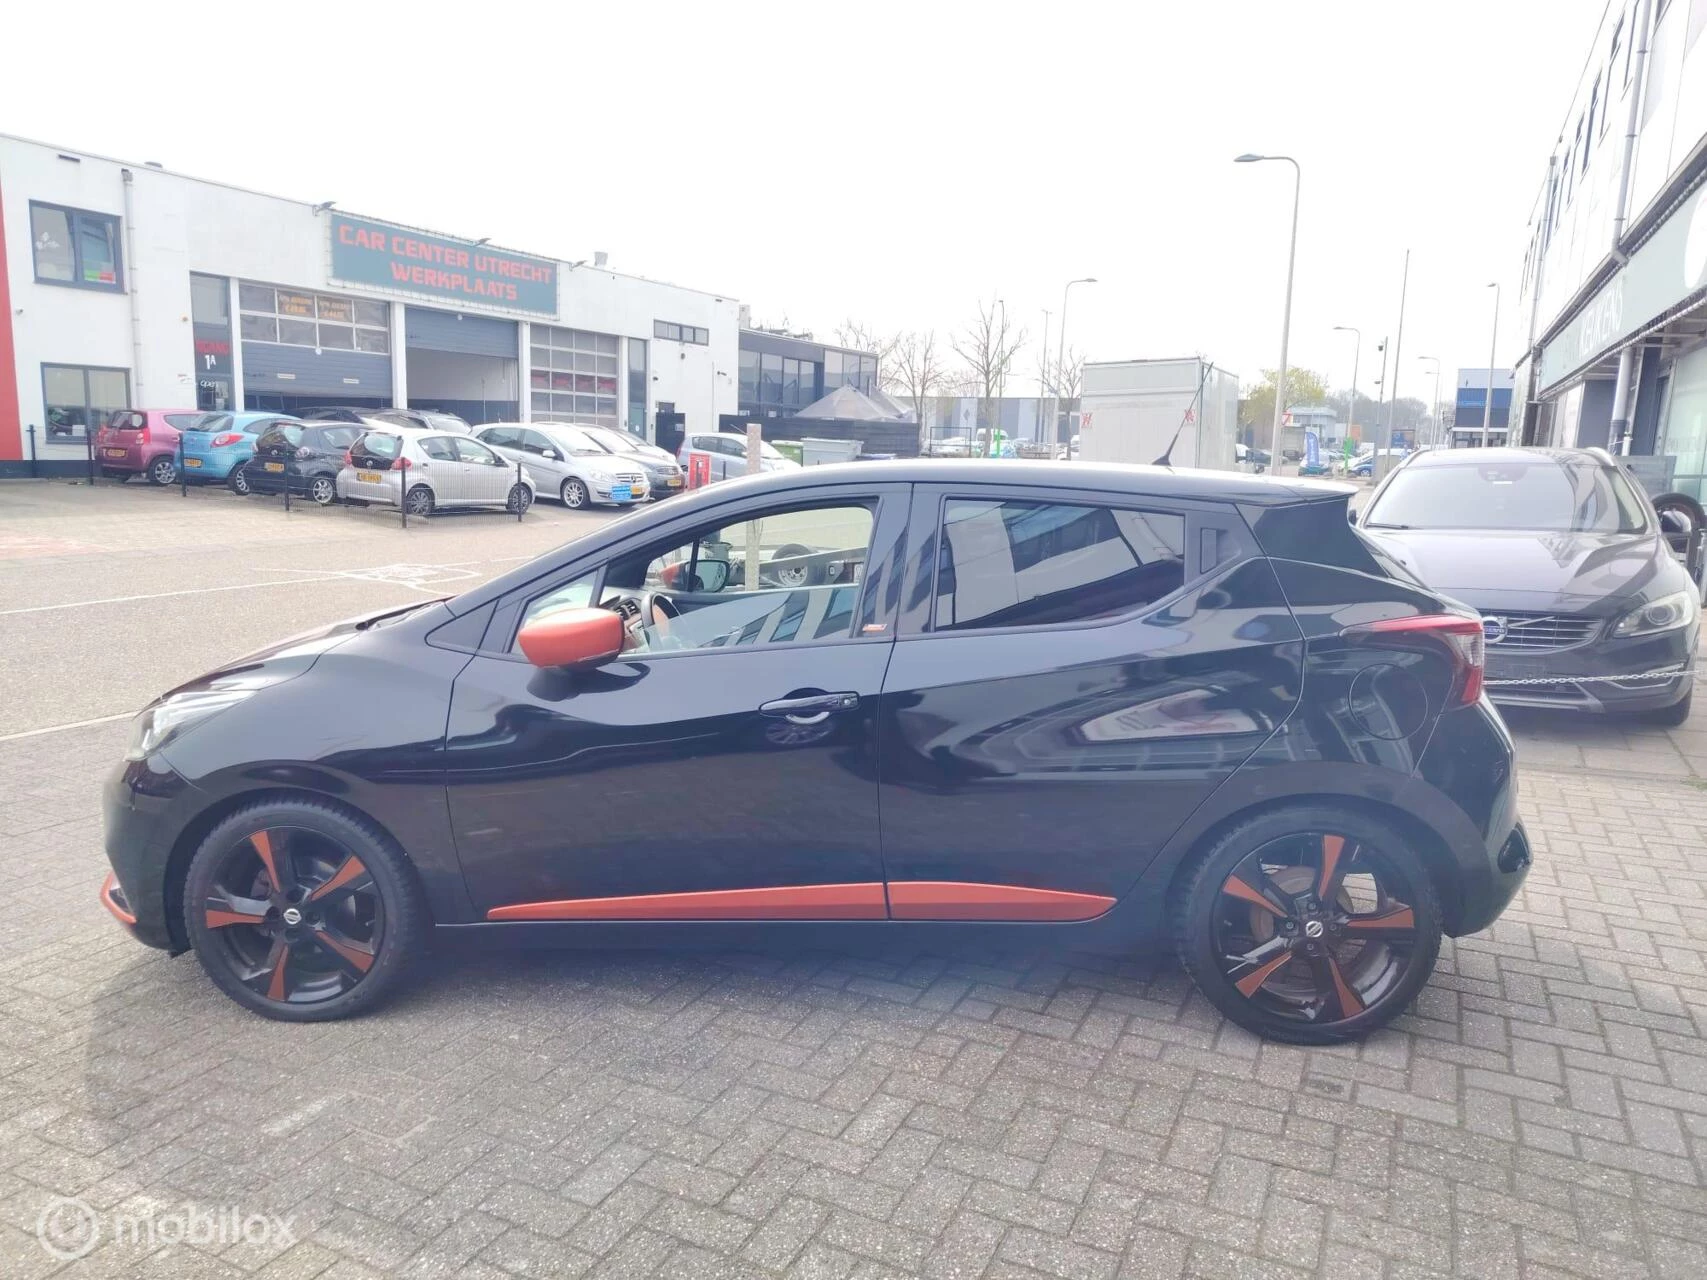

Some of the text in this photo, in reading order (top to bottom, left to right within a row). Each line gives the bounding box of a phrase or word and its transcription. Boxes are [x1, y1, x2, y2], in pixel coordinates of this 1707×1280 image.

[338, 224, 552, 284] CAR CENTER UTRECHT
[390, 261, 517, 301] WERKPLAATS
[204, 354, 216, 370] 1A
